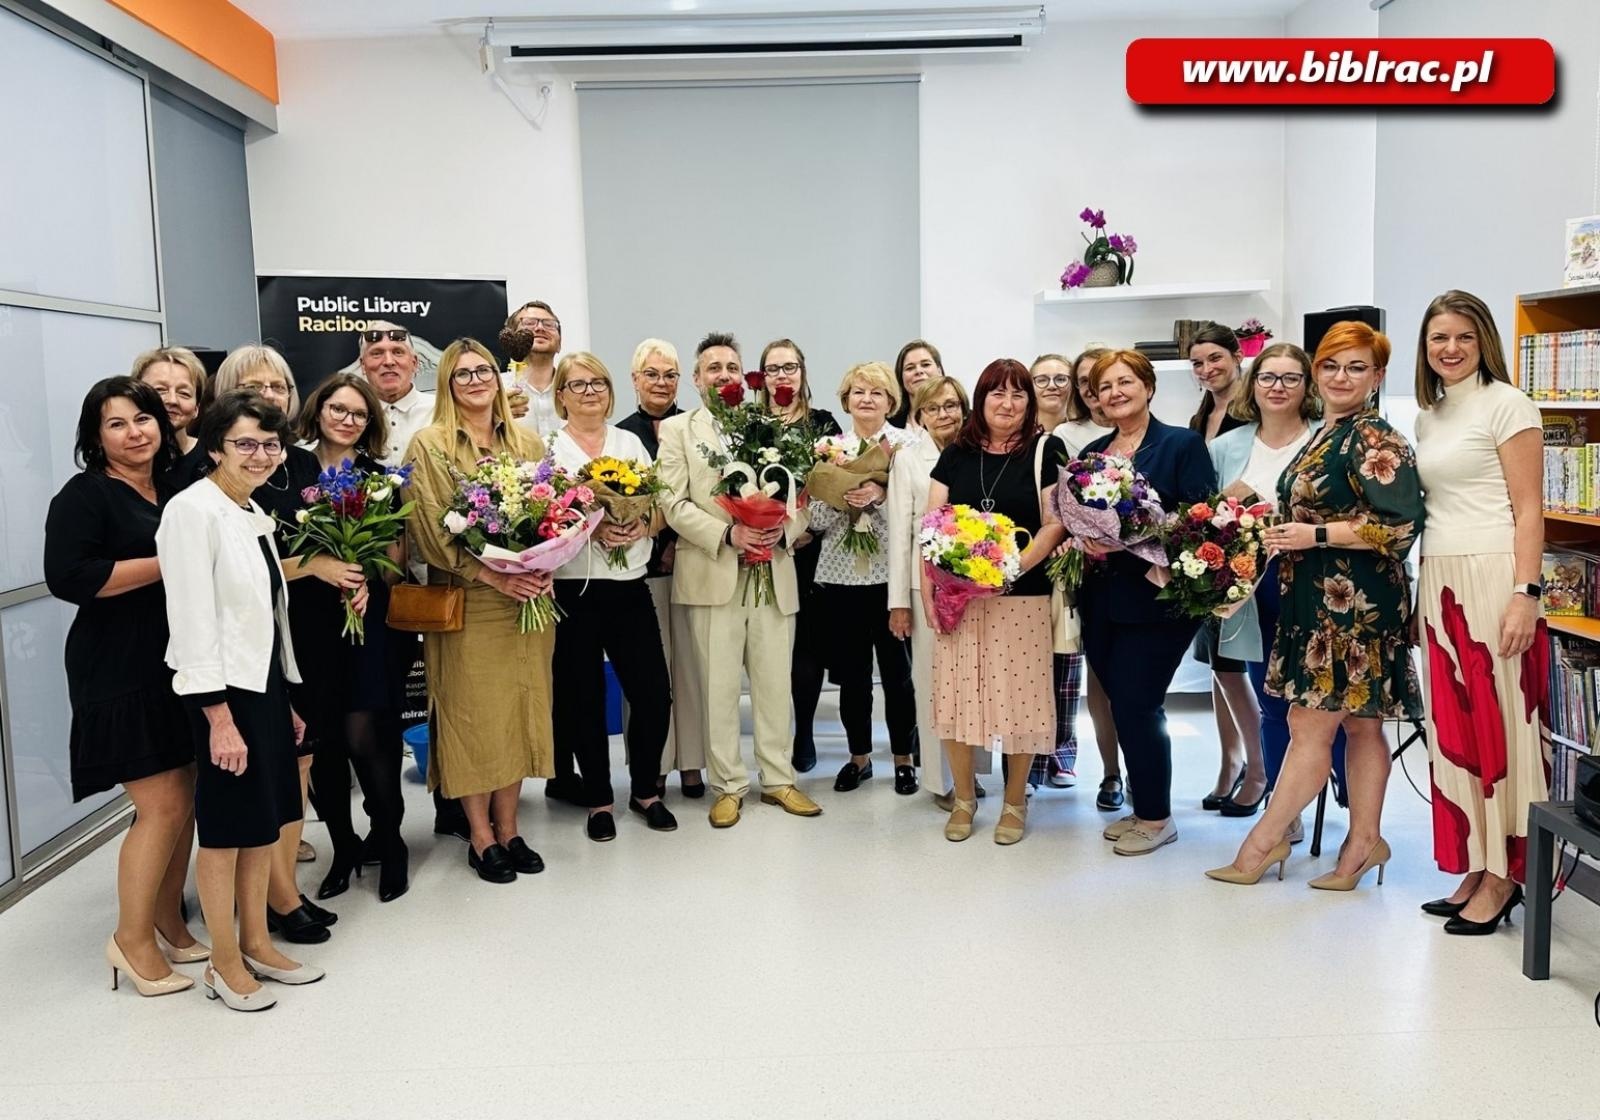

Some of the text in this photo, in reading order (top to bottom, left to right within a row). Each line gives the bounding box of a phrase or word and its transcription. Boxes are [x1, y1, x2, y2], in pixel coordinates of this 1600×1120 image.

[297, 296, 431, 317] Public Library
[299, 315, 374, 332] Racibor
